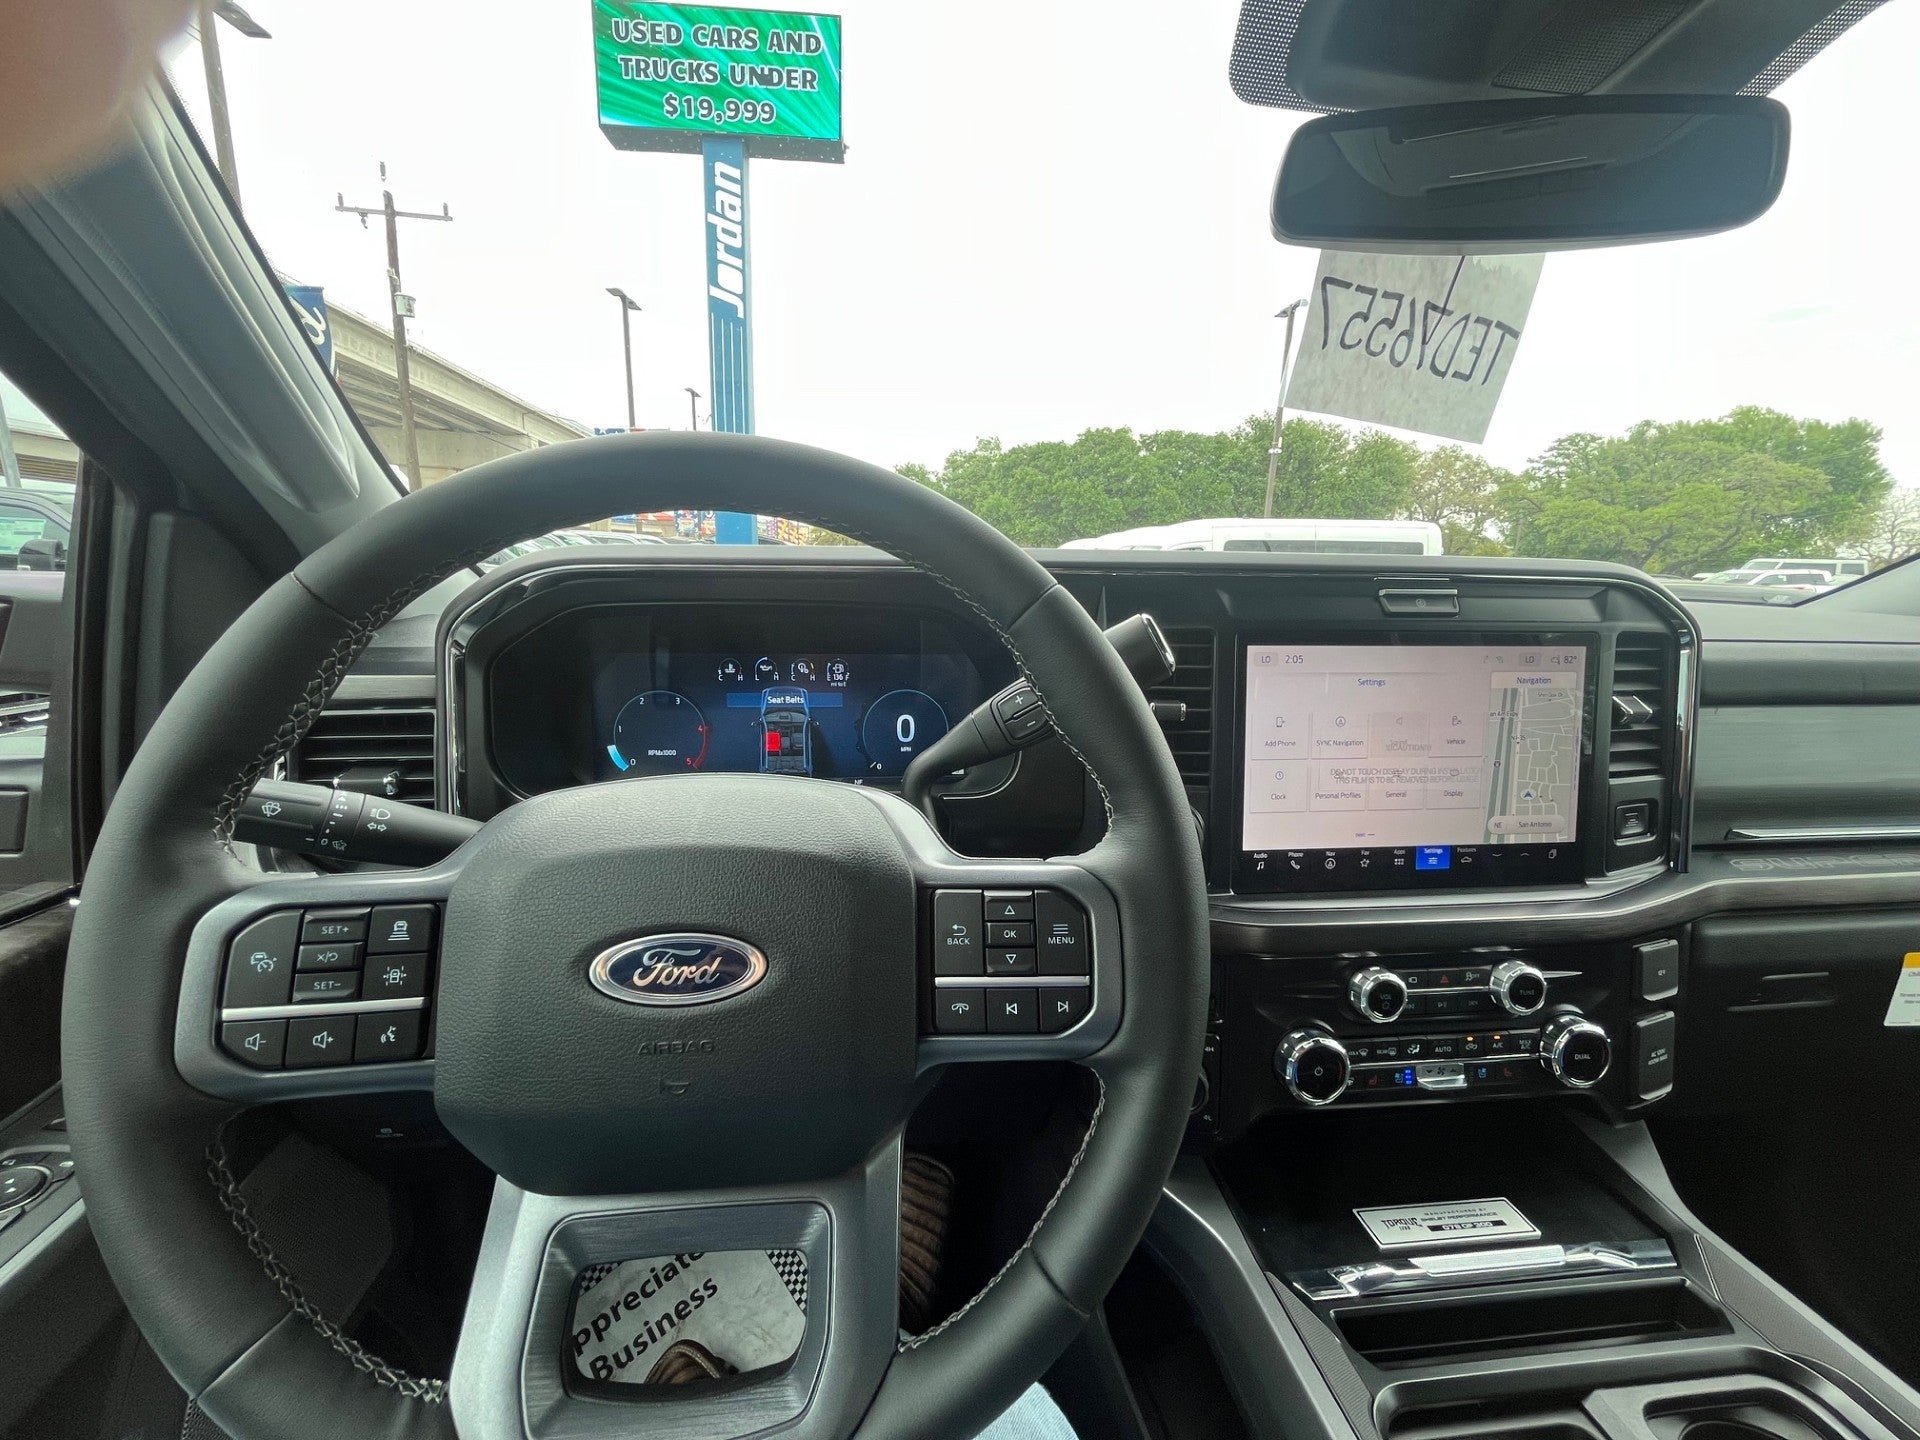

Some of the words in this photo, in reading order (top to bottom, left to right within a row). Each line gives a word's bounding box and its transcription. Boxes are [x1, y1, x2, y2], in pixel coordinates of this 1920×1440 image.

[612, 19, 682, 44] USED
[692, 26, 759, 52] CARS
[767, 30, 822, 54] AND
[618, 56, 719, 84] TRUCKS
[729, 64, 819, 91] UNDER
[663, 93, 775, 123] $19,999
[706, 161, 745, 319] Jordan
[1285, 655, 1304, 664] 2:05
[1563, 655, 1578, 664] 82°
[1358, 678, 1386, 687] Settings
[1516, 676, 1552, 686] Navigation
[640, 697, 645, 705] 2
[675, 697, 681, 705] 3
[767, 696, 785, 704] Seat
[785, 696, 805, 704] Belts
[618, 725, 622, 733] 1
[896, 714, 916, 743] 0
[1316, 739, 1332, 747] SYNC
[1333, 738, 1364, 748] Navigation
[630, 758, 636, 766] 0
[686, 757, 692, 766] 5
[1315, 792, 1340, 800] Personal
[1340, 791, 1362, 800] Profiles
[1385, 791, 1407, 799] General
[1443, 789, 1464, 798] Display
[1423, 847, 1443, 855] Settings
[1253, 852, 1268, 860] Audio
[321, 925, 349, 935] SET+
[1003, 929, 1017, 939] OK
[946, 937, 971, 946] BACK
[1047, 936, 1075, 945] MENU
[632, 948, 723, 987] Ford
[637, 1039, 716, 1056] AIRBAG
[1434, 1045, 1452, 1053] AUTO
[1574, 1053, 1591, 1061] DUAL
[588, 1277, 719, 1381] Business
